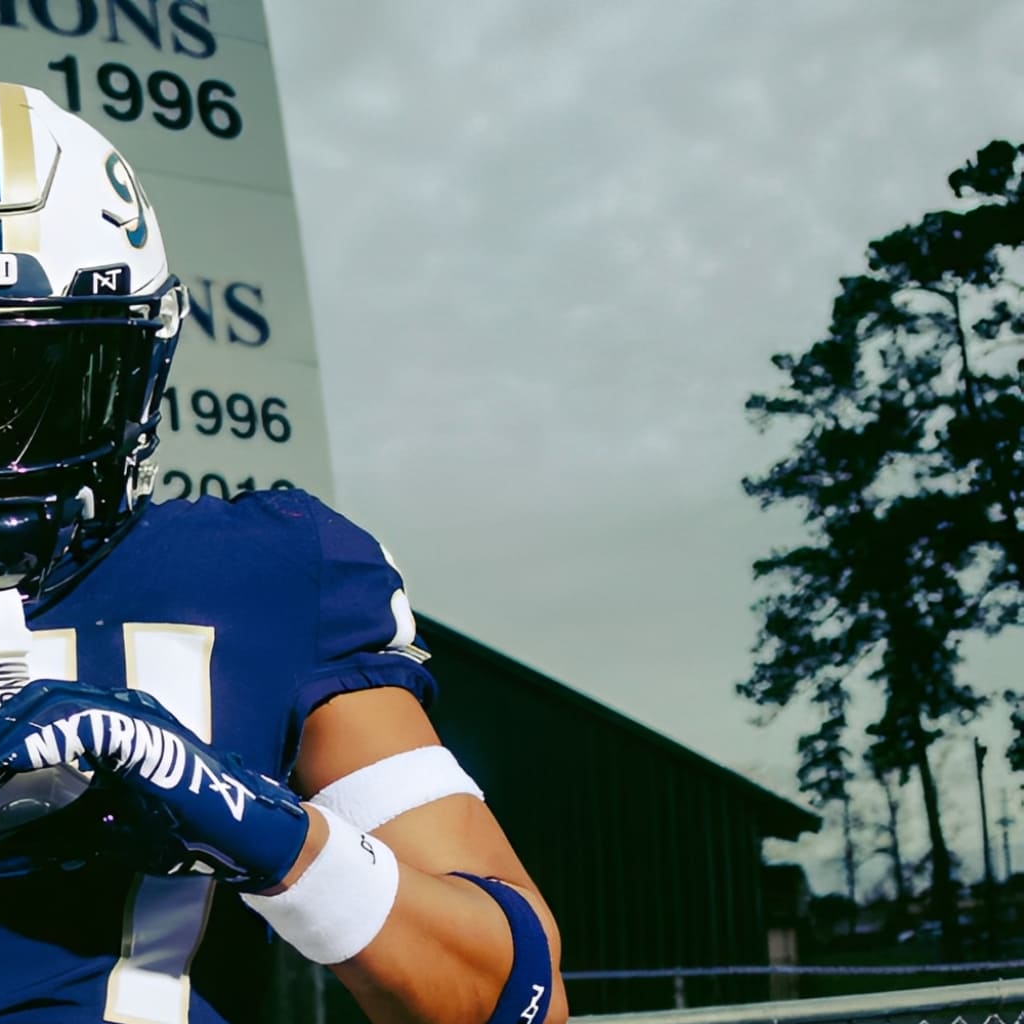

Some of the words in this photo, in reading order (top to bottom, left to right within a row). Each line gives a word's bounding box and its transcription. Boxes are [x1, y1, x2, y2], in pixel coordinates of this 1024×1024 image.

[47, 54, 243, 140] 1996
[162, 386, 292, 444] 1996
[24, 709, 187, 790] NXTRND
